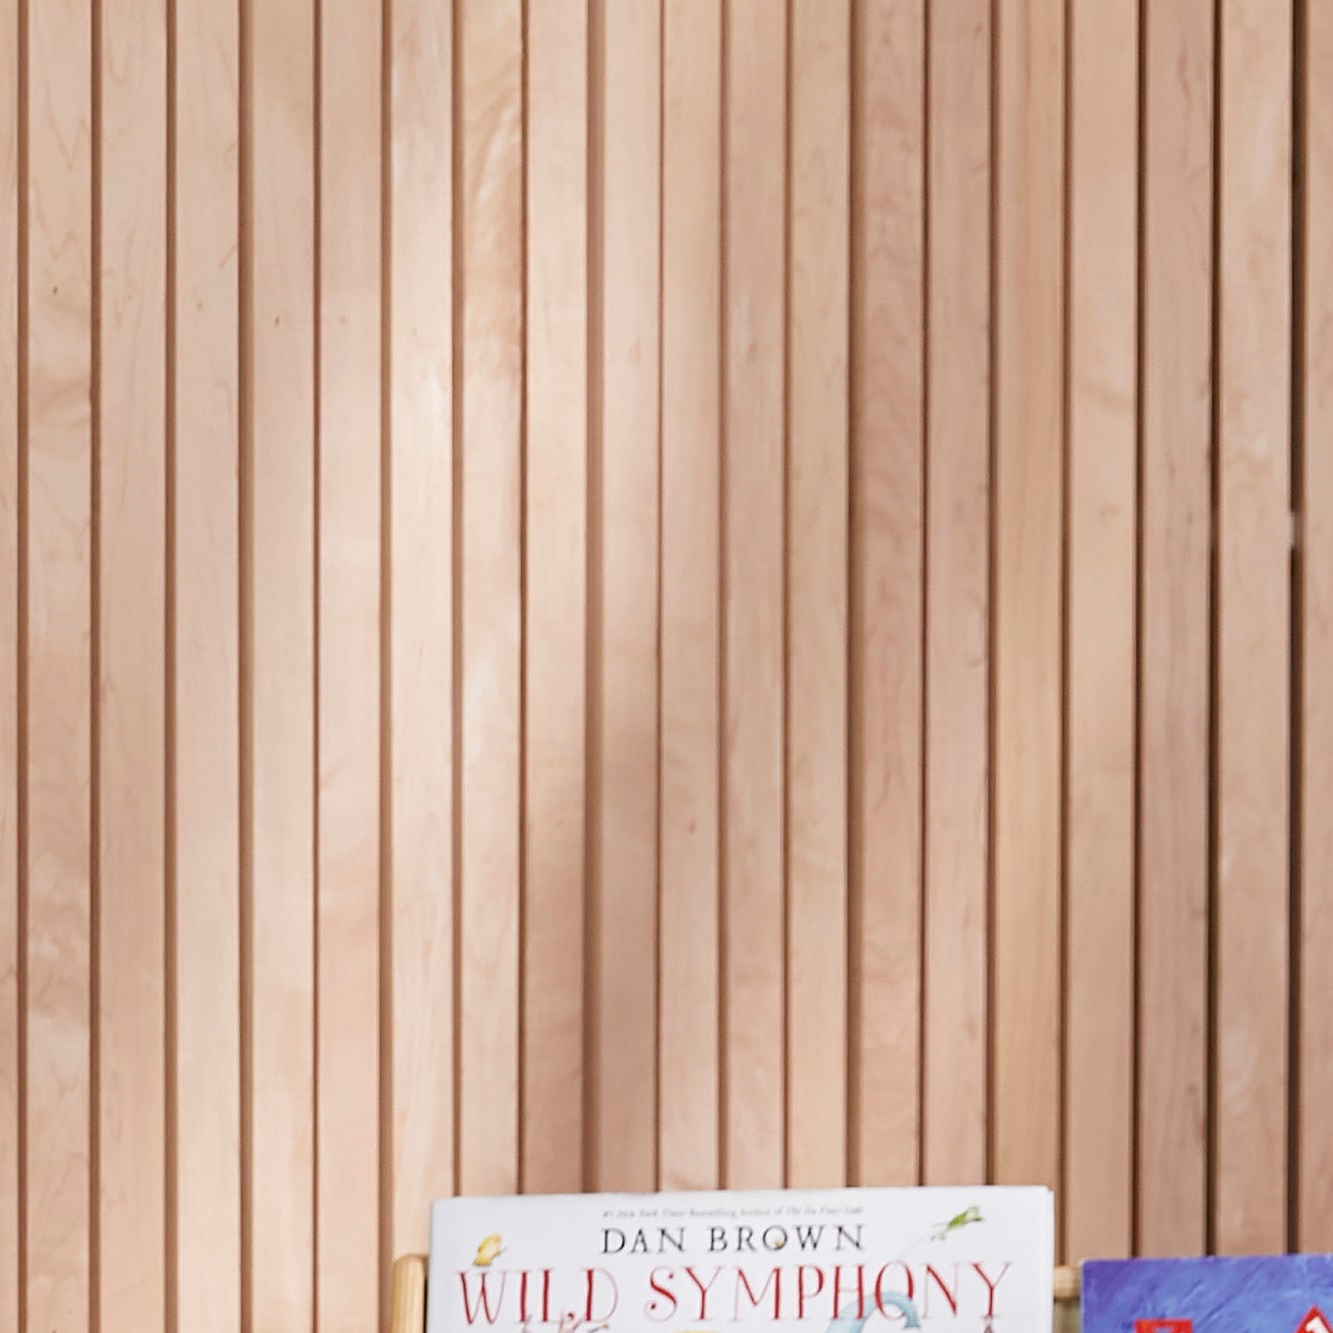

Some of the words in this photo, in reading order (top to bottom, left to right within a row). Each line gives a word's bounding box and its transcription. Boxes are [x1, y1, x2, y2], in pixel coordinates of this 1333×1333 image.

[601, 1226, 686, 1254] DAN
[708, 1224, 864, 1252] BROWN
[456, 1267, 620, 1326] WILD
[644, 1261, 1013, 1321] SYMPHONY
